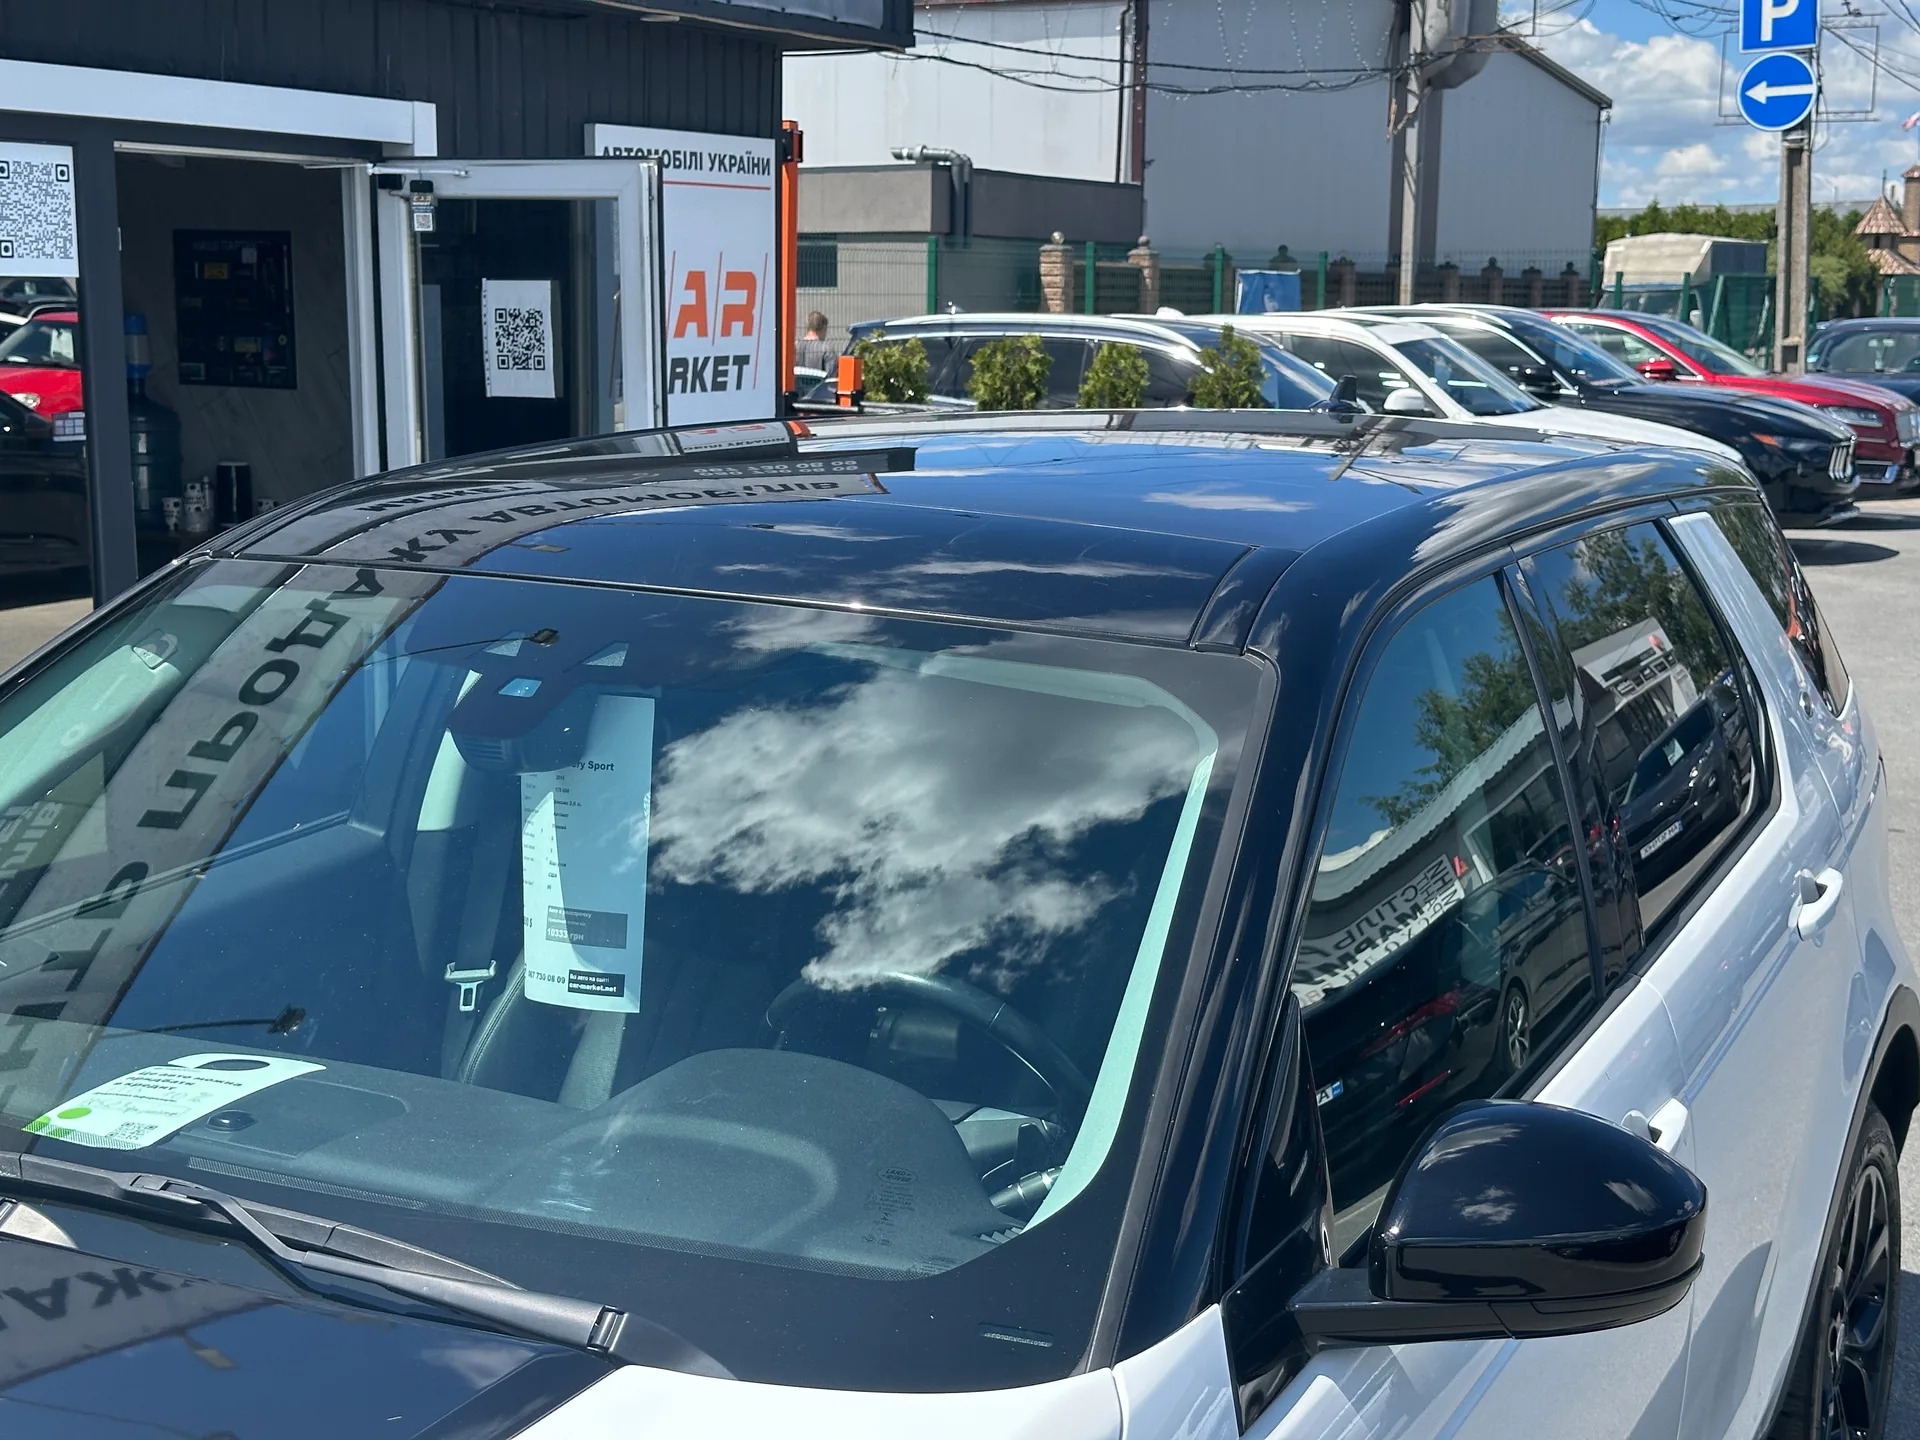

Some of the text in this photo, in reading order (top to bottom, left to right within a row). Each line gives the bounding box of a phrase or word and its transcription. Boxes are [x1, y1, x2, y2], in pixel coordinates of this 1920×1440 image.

[1761, 0, 1800, 42] P
[708, 151, 771, 176] УКРАЇНИ
[673, 270, 757, 338] AR
[667, 354, 751, 395] RKET
[588, 760, 615, 772] Sport
[536, 972, 547, 980] 730
[547, 974, 556, 982] 08
[557, 976, 566, 984] 09
[885, 1168, 907, 1176] LAND
